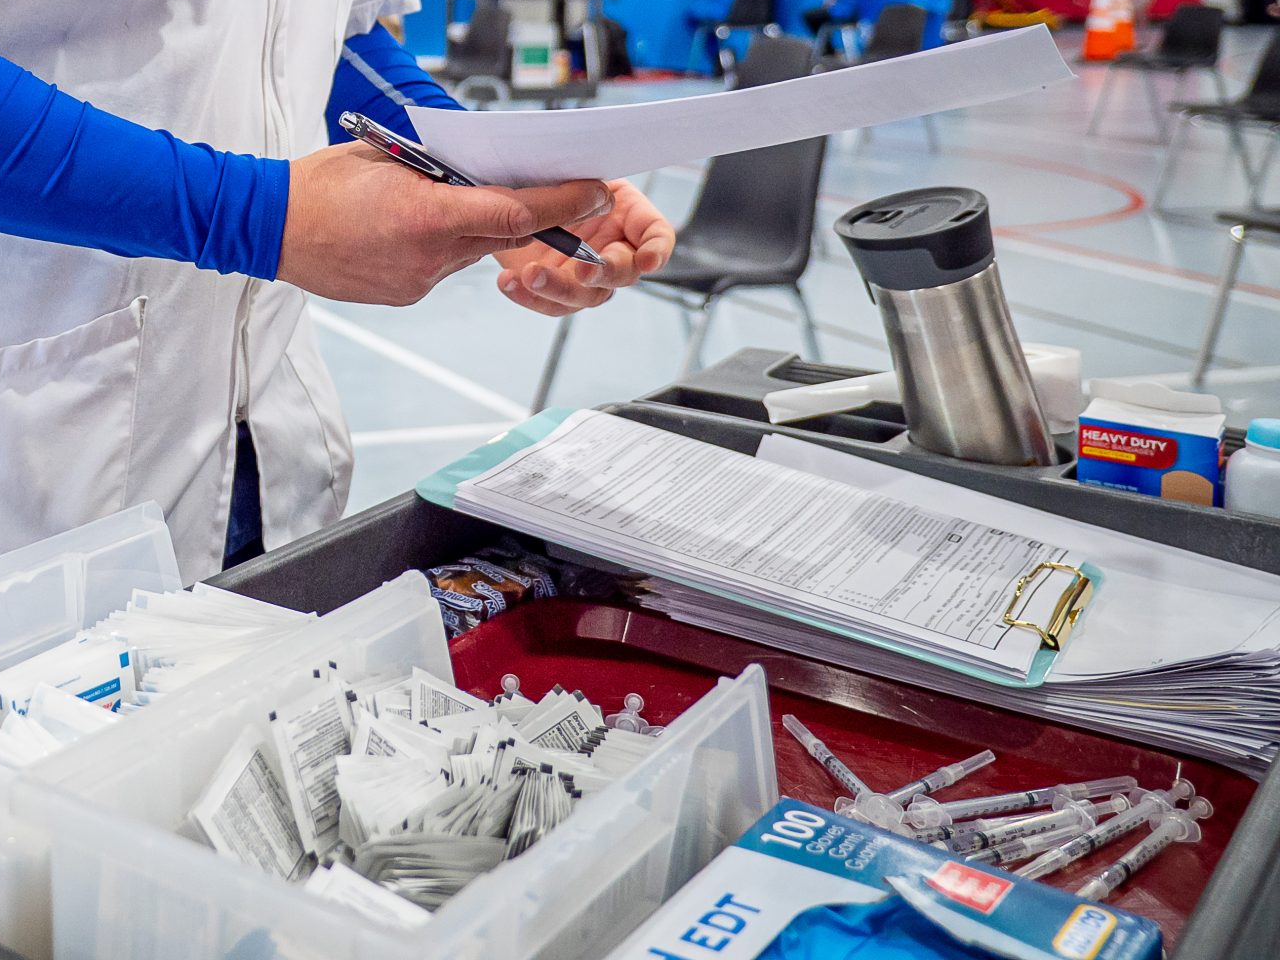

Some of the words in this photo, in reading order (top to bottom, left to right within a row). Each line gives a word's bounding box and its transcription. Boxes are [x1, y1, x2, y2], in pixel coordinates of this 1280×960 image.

[1082, 429, 1128, 446] HEAVY
[1130, 436, 1167, 452] DUTY
[760, 810, 826, 849] 100
[805, 824, 845, 855] Gloves
[828, 832, 865, 858] Gants
[680, 892, 761, 952] EDT
